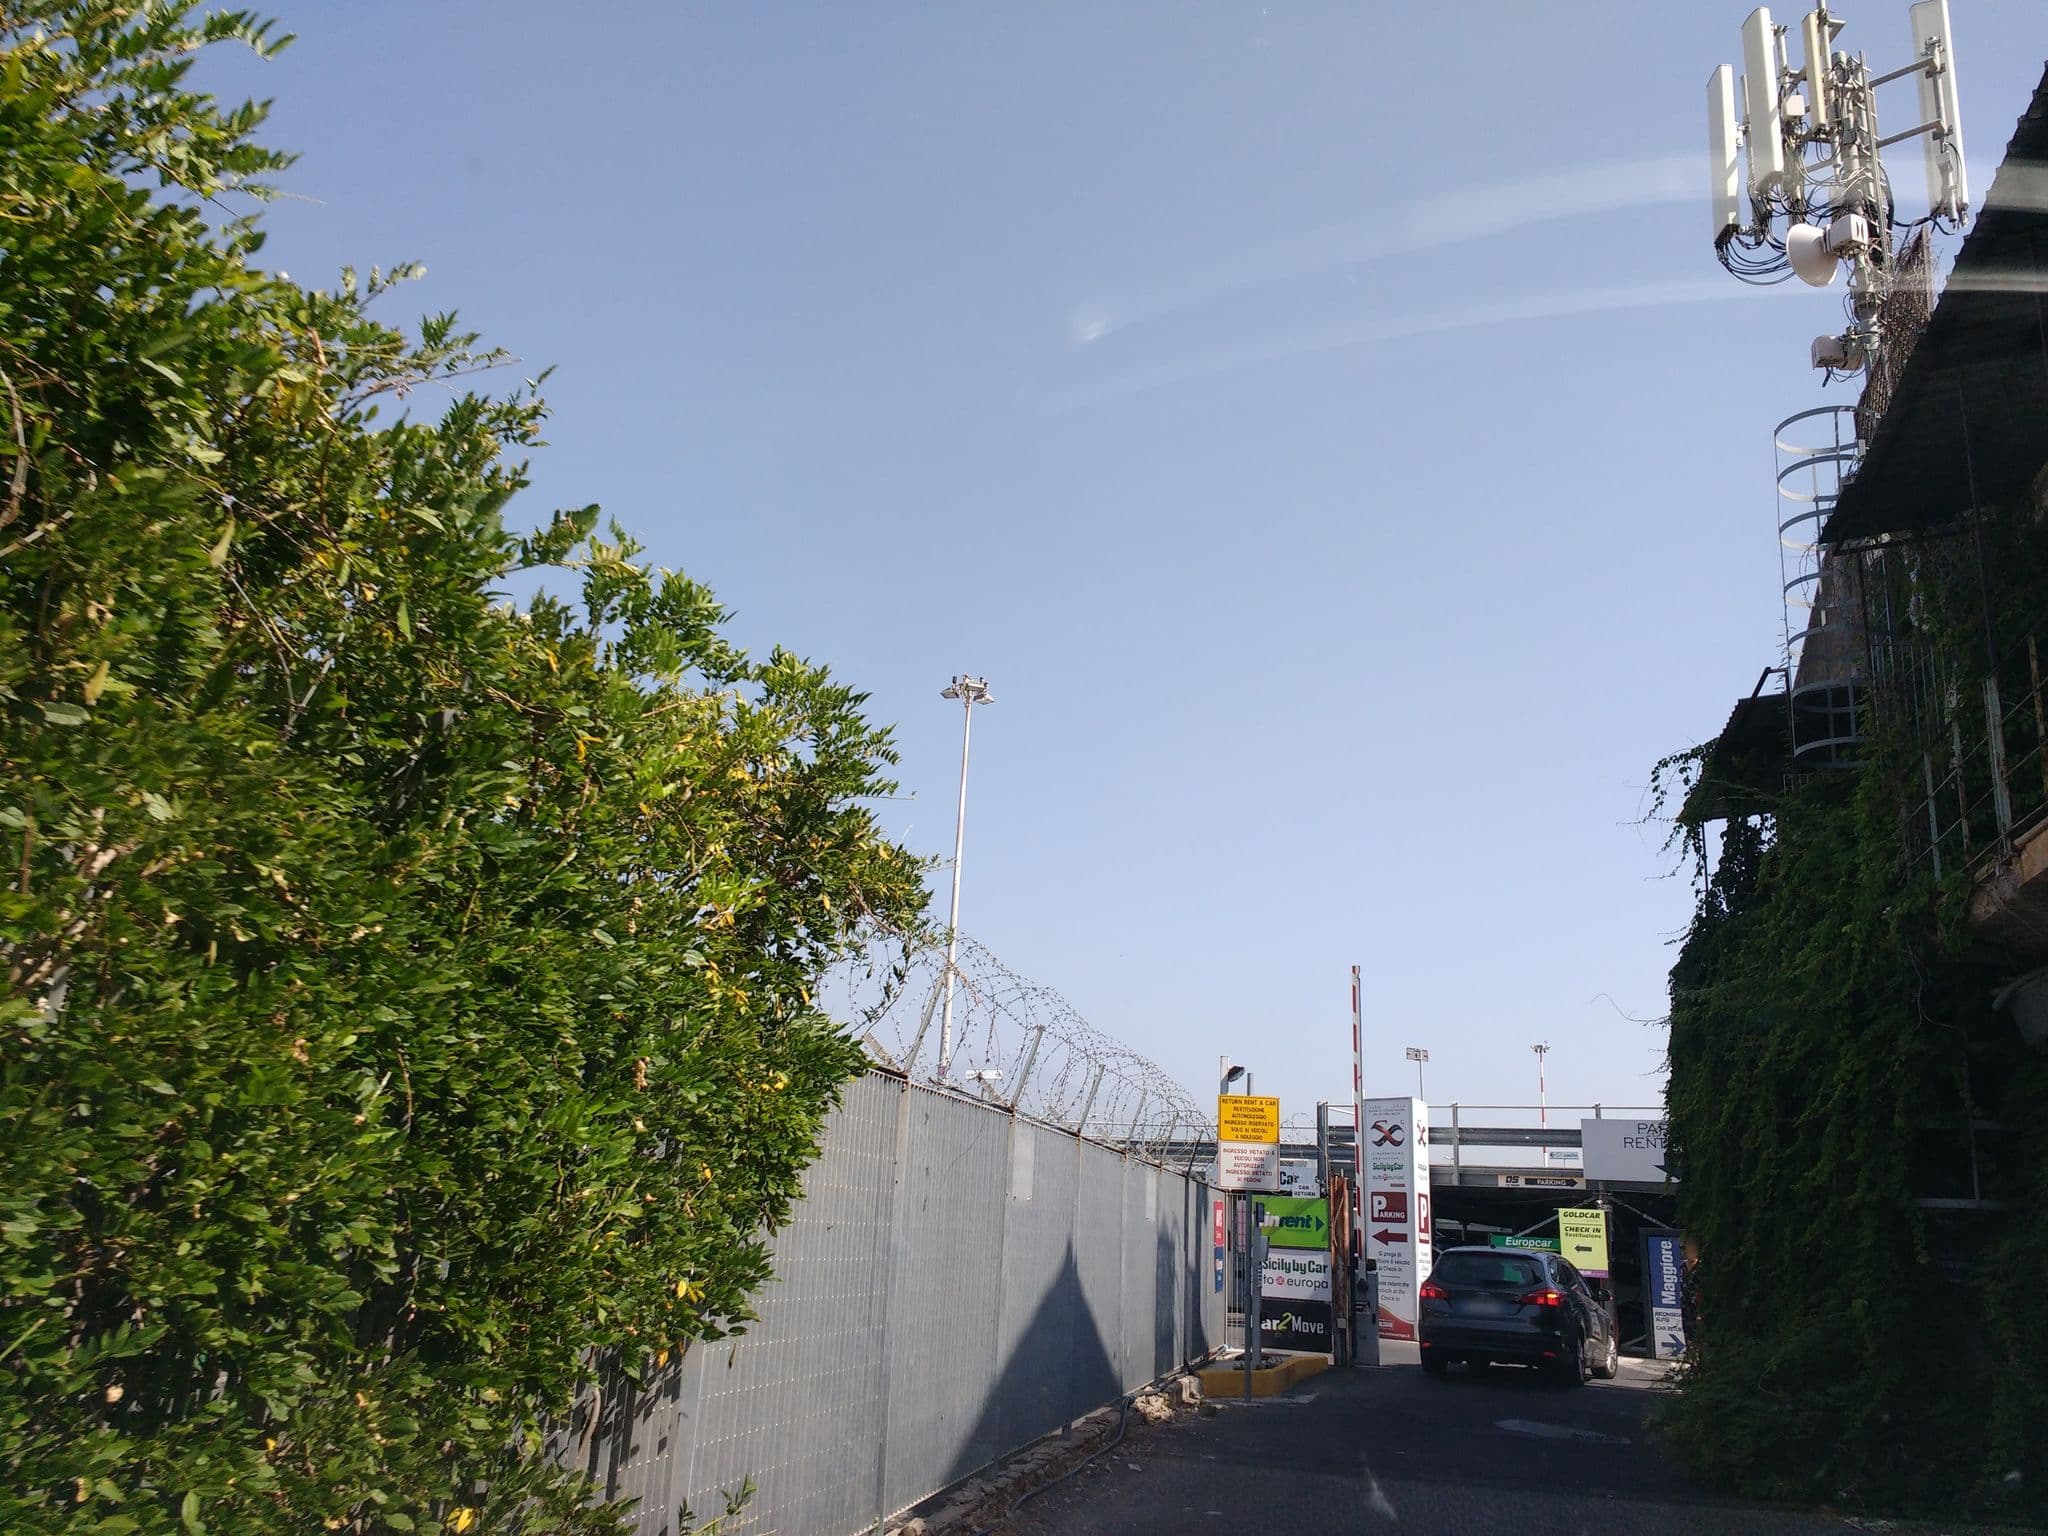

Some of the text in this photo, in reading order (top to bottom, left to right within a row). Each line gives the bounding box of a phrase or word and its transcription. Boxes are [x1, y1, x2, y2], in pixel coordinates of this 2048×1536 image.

[1280, 1171, 1300, 1185] Car
[1537, 1178, 1567, 1186] PARKING
[1373, 1196, 1405, 1218] PARKING
[1563, 1211, 1600, 1219] GOLDCAR
[1505, 1237, 1552, 1248] Europcar
[1308, 1260, 1328, 1274] Car
[1660, 1240, 1677, 1305] Maggiore
